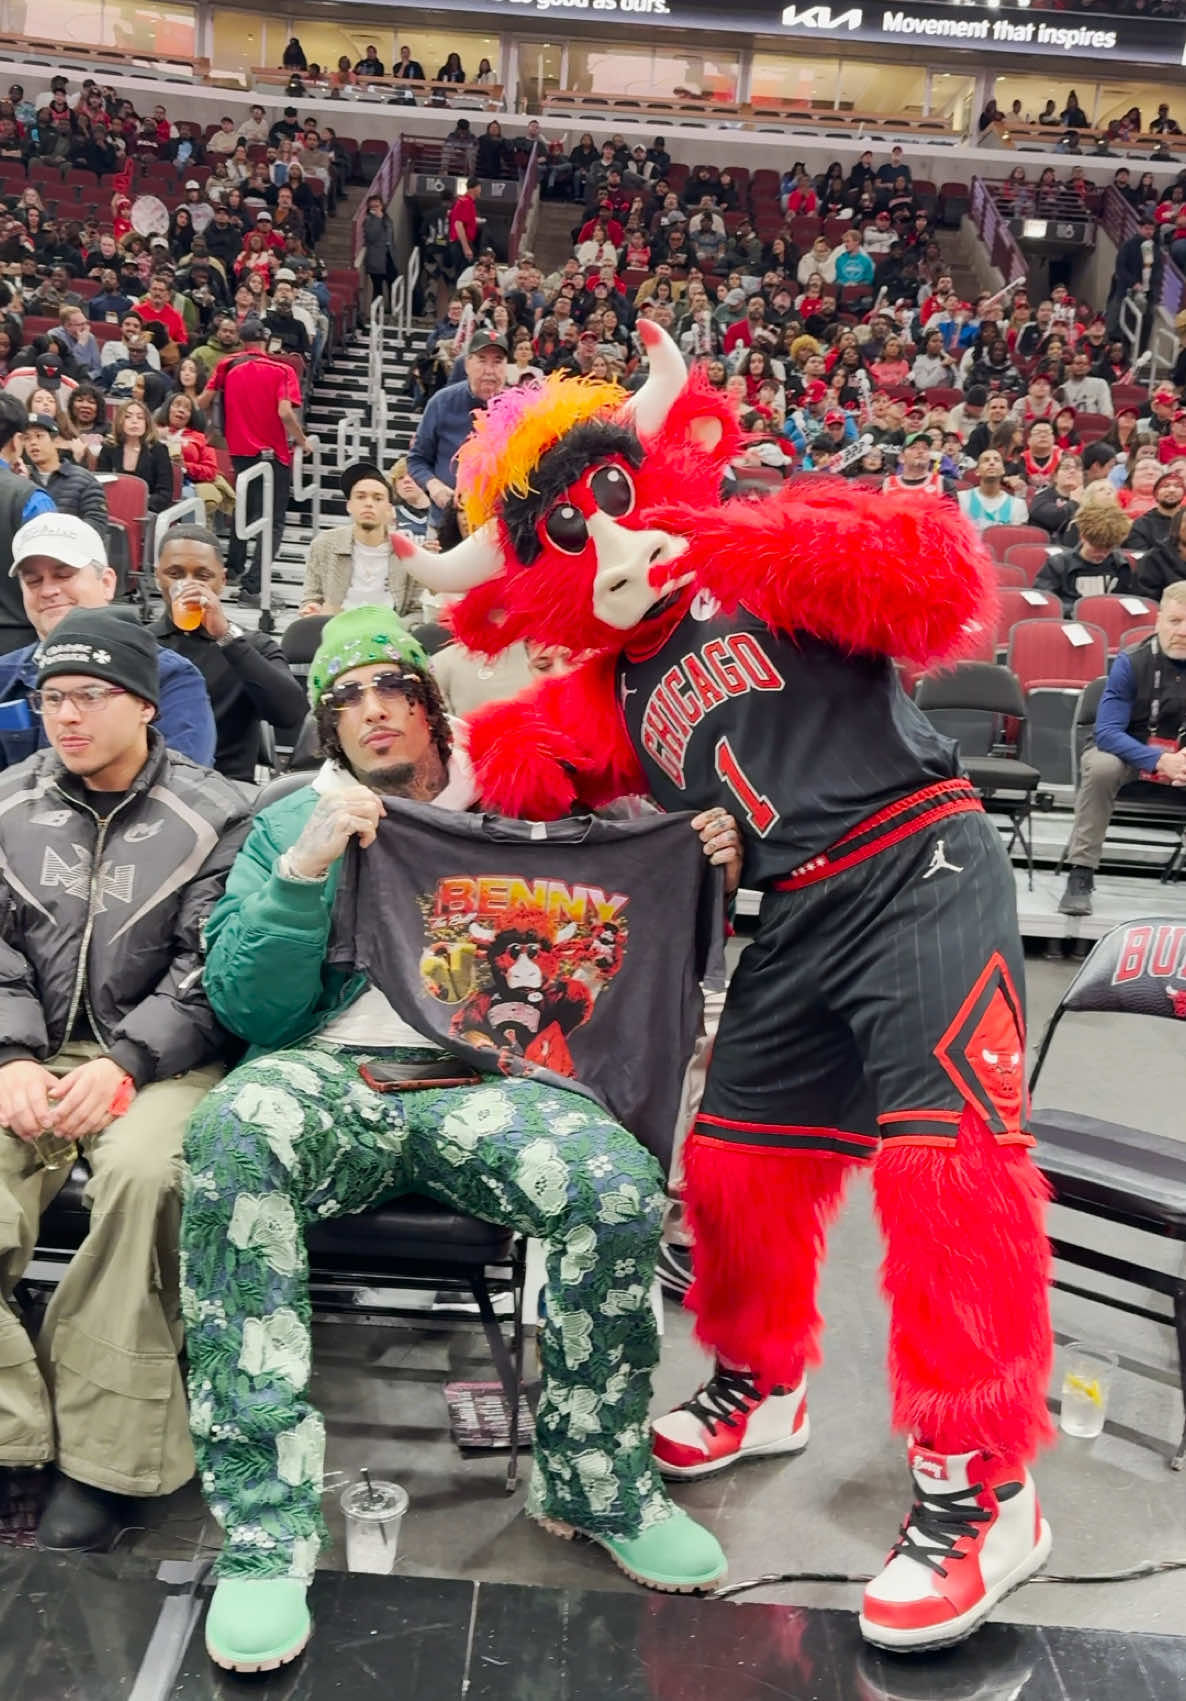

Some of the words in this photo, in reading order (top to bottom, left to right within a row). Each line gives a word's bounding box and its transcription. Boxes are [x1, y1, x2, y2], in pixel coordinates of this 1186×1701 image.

[593, 0, 617, 9] as
[620, 0, 670, 13] ours.
[882, 11, 990, 38] Movement
[991, 19, 1035, 42] that
[1037, 23, 1117, 50] inspires
[641, 631, 786, 791] CHICAGO
[715, 735, 781, 839] 1
[435, 874, 631, 922] BENNY
